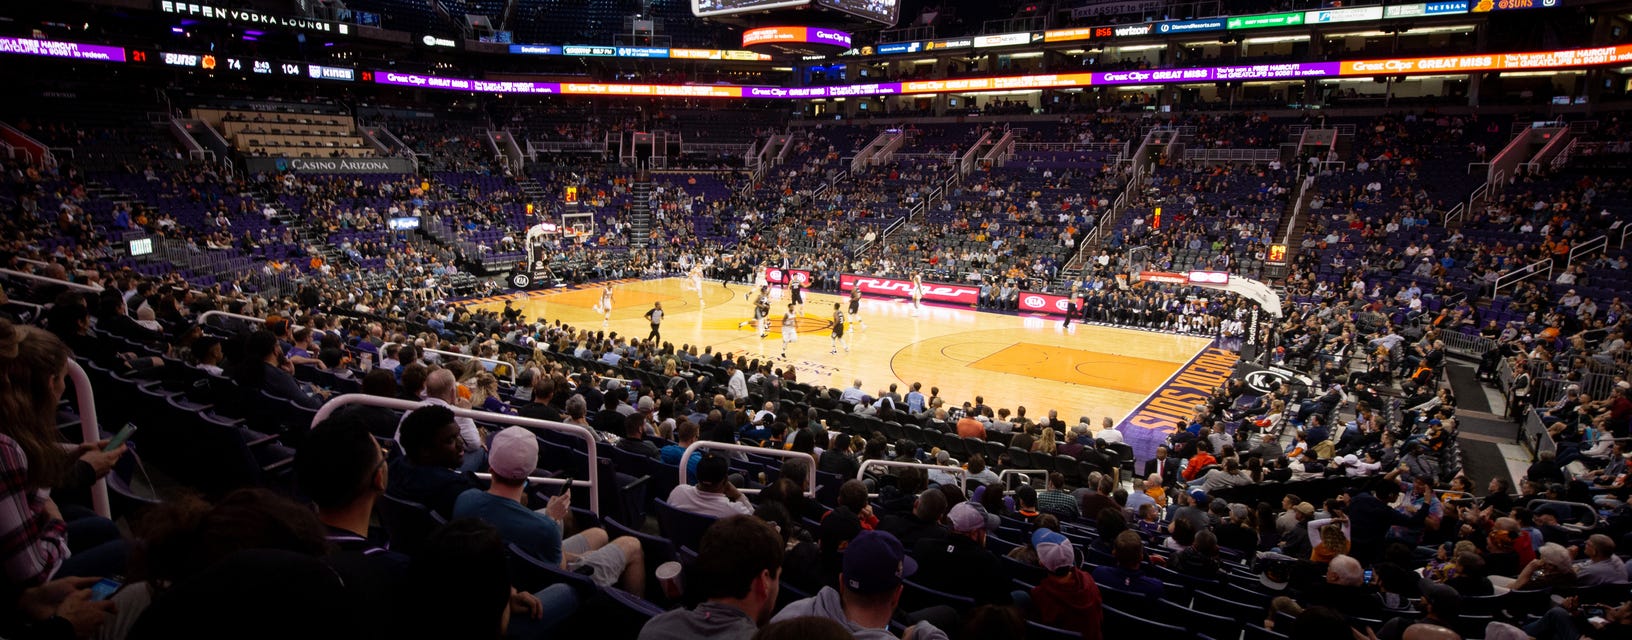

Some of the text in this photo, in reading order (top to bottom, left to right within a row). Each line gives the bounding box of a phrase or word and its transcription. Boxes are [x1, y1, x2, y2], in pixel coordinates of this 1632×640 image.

[1498, 0, 1533, 9] @SUNS
[1093, 5, 1124, 15] ASSIST
[162, 1, 330, 31] EFFEN VODKA LOUNGE
[1096, 27, 1112, 37] 8:56
[1115, 25, 1149, 37] verizon
[133, 51, 145, 61] 21
[1577, 47, 1616, 57] HAIRCUT!
[165, 53, 197, 66] SUNS
[227, 59, 241, 70] 74
[1353, 57, 1491, 71] Great Clips GREAT MISS
[1520, 57, 1572, 66] GREATCLIPS
[282, 64, 299, 74] 104
[362, 72, 371, 81] 21
[1104, 69, 1207, 82] Great Clips GREAT MISS
[292, 159, 389, 170] CASINO ARIZONA
[1237, 309, 1258, 345] Southwest
